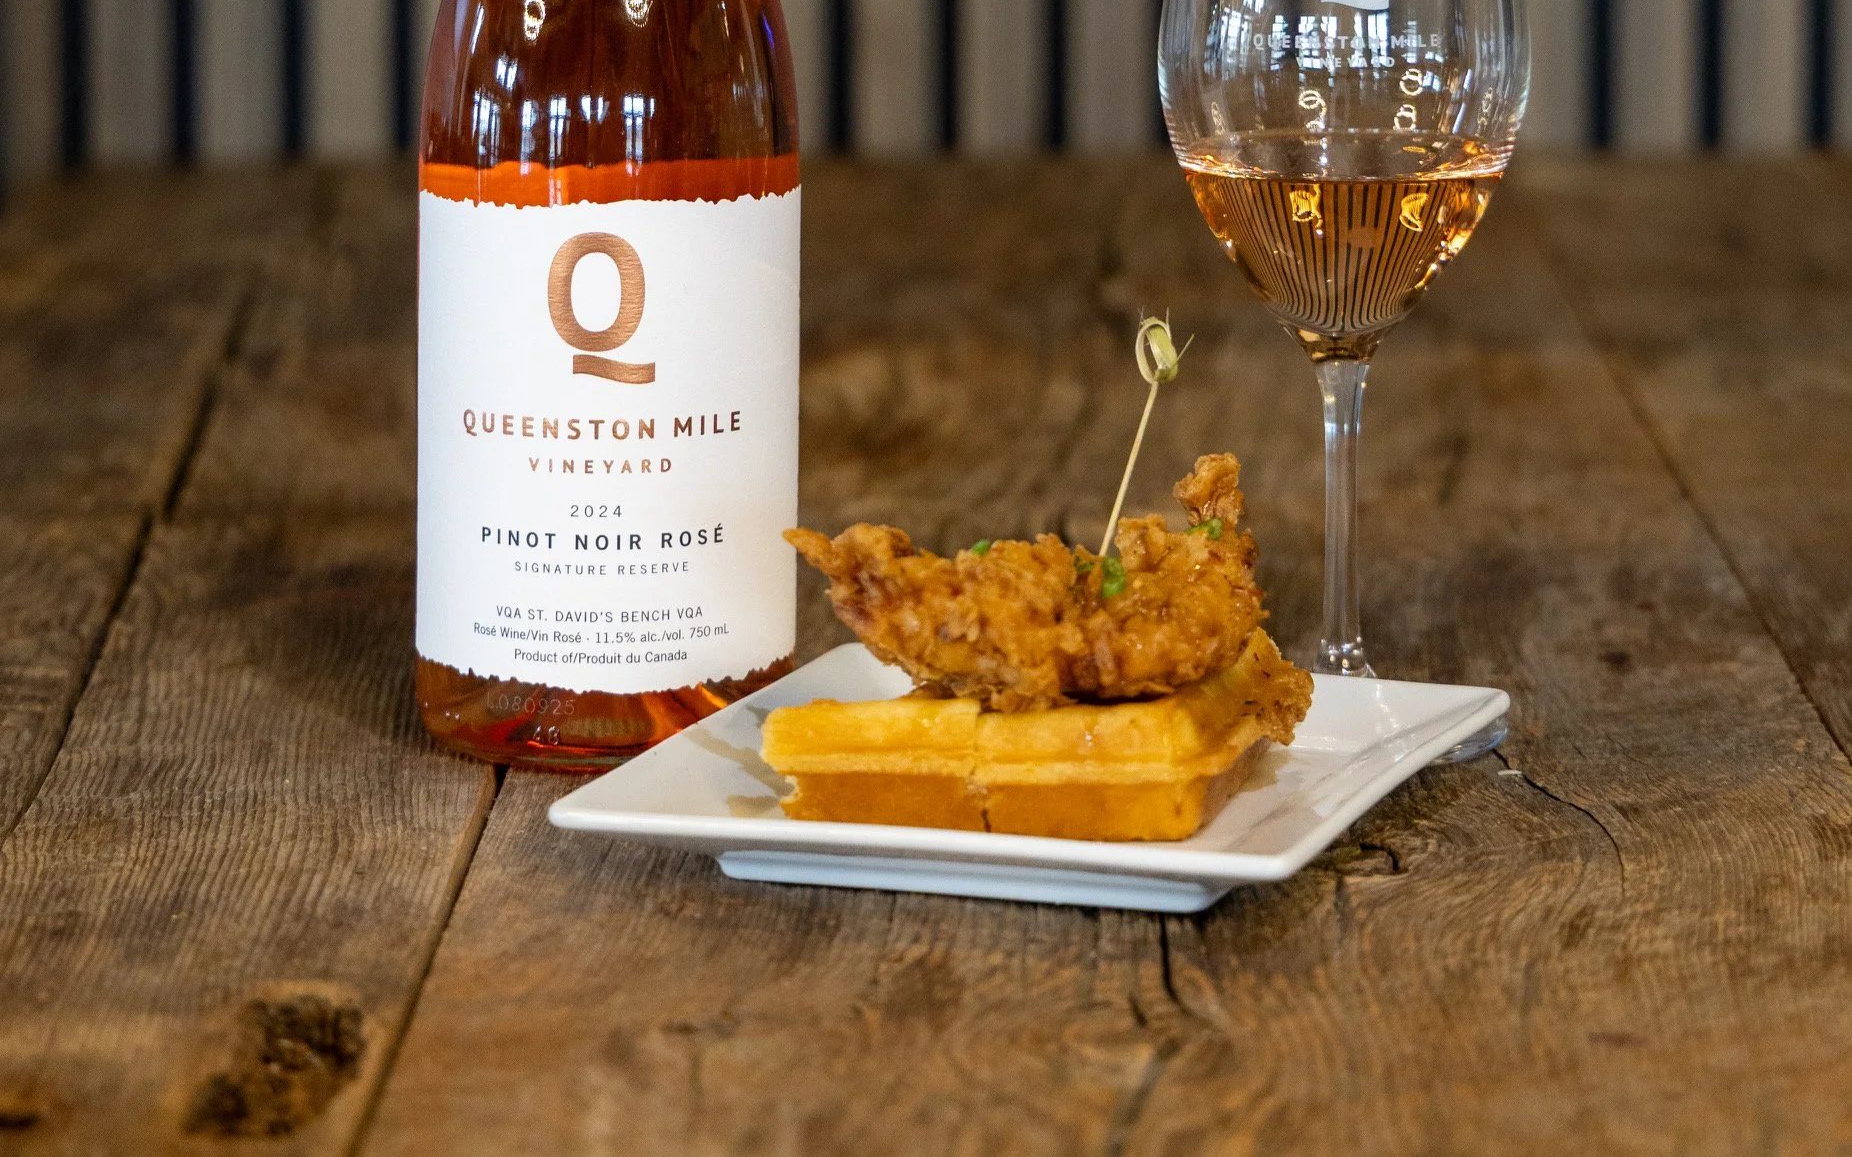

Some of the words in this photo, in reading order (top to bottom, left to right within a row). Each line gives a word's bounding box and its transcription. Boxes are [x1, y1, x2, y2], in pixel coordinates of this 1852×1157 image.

[547, 231, 656, 385] Q
[463, 408, 656, 441] QUEENSTON
[673, 410, 741, 439] MILE
[528, 457, 672, 474] VINEYARD
[570, 504, 623, 518] 2024
[481, 525, 557, 550] PINOT
[574, 533, 642, 551] NOIR
[660, 522, 724, 549] ROSÉ
[514, 560, 607, 576] SIGNATURE
[617, 560, 689, 576] RESERVE
[496, 605, 522, 619] VQA
[527, 608, 548, 621] ST.
[555, 610, 614, 623] DAVID'S
[620, 609, 671, 623] BENCH
[676, 606, 703, 620] VQA
[473, 621, 497, 637] Rosé
[499, 626, 549, 642] Wine/Vin
[553, 630, 582, 644] Rosé
[595, 631, 636, 644] 11.5%
[640, 628, 686, 643] alc./vol.
[689, 626, 711, 639] 750
[714, 623, 730, 636] mL
[514, 648, 558, 664] Product
[561, 651, 622, 665] of/Produit
[625, 652, 641, 664] du
[644, 648, 688, 663] Canada
